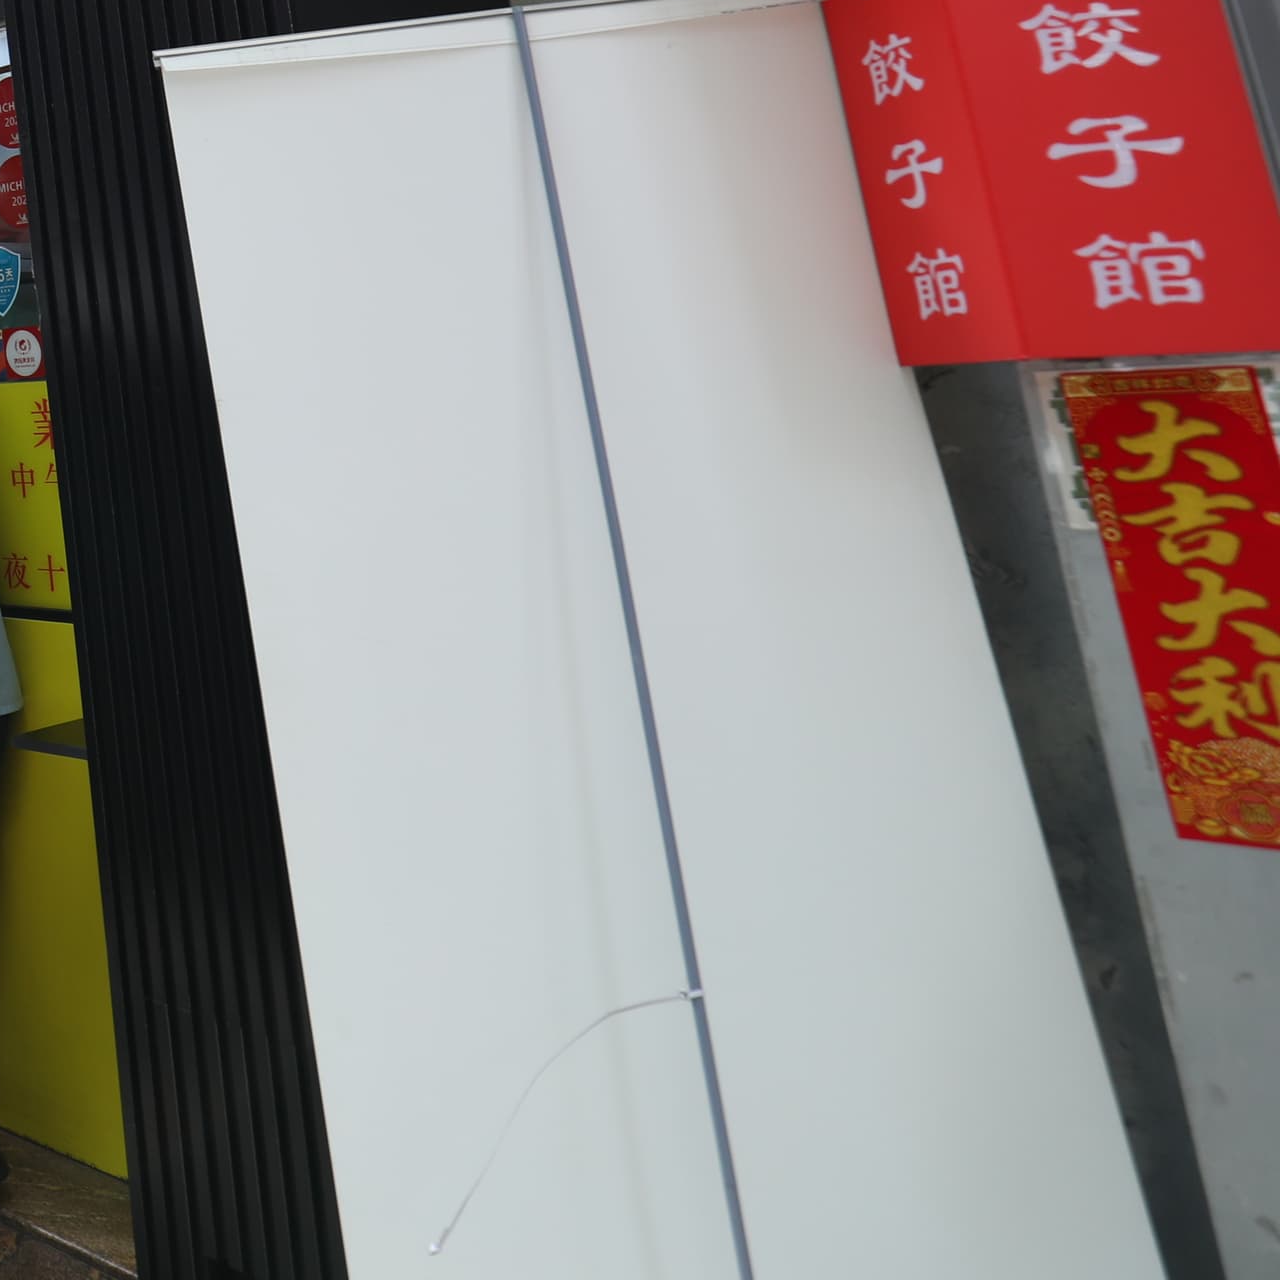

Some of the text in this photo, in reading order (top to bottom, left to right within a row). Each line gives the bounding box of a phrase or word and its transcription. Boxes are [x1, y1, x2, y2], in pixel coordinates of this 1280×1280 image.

[2, 552, 66, 593] 夜十
[1113, 400, 1280, 739] 大吉大利
